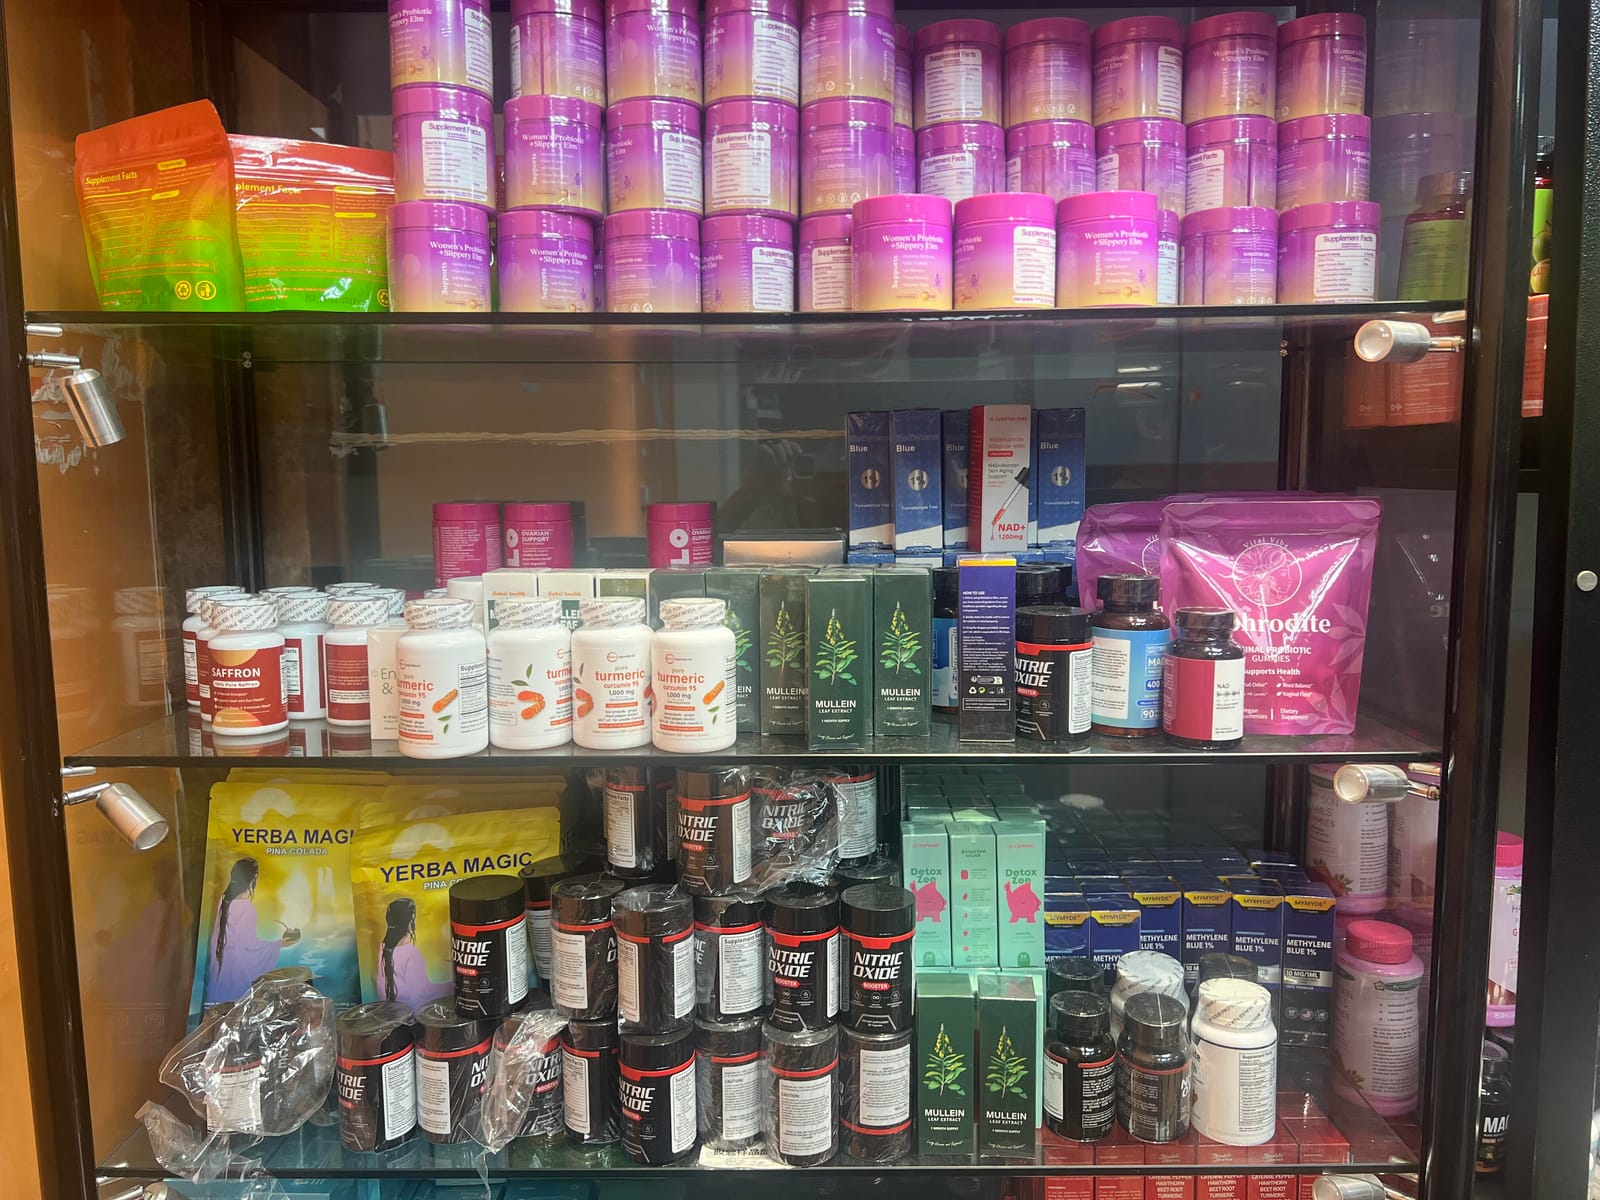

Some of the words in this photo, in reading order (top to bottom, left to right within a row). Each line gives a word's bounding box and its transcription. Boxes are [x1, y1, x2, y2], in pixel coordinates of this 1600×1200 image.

[962, 50, 976, 58] Facts
[428, 122, 466, 134] Supplement
[466, 125, 482, 136] Facts
[716, 135, 747, 144] Supplement
[562, 141, 578, 150] Elm
[85, 172, 122, 186] Supplement
[882, 234, 916, 242] Women's
[1084, 230, 1120, 240] Women's
[1323, 234, 1358, 244] Supplement
[1359, 234, 1373, 242] Facts
[430, 242, 464, 252] Women's
[892, 242, 924, 250] +Slippery
[1093, 238, 1128, 247] +Slippery
[1128, 238, 1143, 246] Elm
[439, 250, 472, 260] +Slippery
[530, 248, 563, 257] Women's
[539, 256, 571, 266] +Slippery
[572, 258, 584, 266] Elm
[1094, 252, 1102, 287] Supports
[850, 444, 868, 452] Blue
[896, 444, 916, 452] Blue
[946, 444, 965, 452] Blue
[1040, 442, 1059, 450] Blue
[910, 476, 926, 486] 1%
[1054, 472, 1069, 482] 1%
[998, 523, 1026, 532] NAD+
[1243, 537, 1266, 549] Vital
[1270, 537, 1289, 550] Vibe
[1234, 612, 1332, 634] hrodite
[1266, 646, 1312, 654] PROBIOTIC
[1015, 660, 1054, 674] NITRIC
[212, 668, 260, 678] SAFFRON
[595, 669, 646, 681] turmeric
[658, 672, 704, 684] turmeric
[398, 680, 434, 690] rmeric
[1015, 674, 1050, 688] OXIDE
[1147, 680, 1160, 688] 400
[382, 683, 393, 695] &
[766, 688, 803, 696] MULLEIN
[881, 688, 920, 696] MULLEIN
[816, 700, 856, 708] MULLEIN
[1142, 710, 1154, 719] 90
[678, 813, 718, 829] NITRIC
[232, 828, 298, 844] YERBA
[304, 829, 354, 844] MAGI
[678, 828, 714, 842] OXIDE
[380, 863, 456, 884] YERBA
[462, 852, 534, 874] MAGIC
[911, 868, 942, 876] Detox
[1006, 868, 1037, 876] Detox
[452, 937, 492, 954] NITRIC
[1141, 942, 1154, 950] LUE
[1155, 942, 1164, 950] 1%
[1235, 936, 1280, 946] METHYLENE
[1286, 940, 1332, 949] METHYLENE
[1235, 944, 1254, 952] BLUE
[1286, 947, 1305, 955] BLUE
[1306, 948, 1317, 956] 1%
[451, 952, 488, 966] OXIDE
[769, 946, 815, 965] NITRIC
[854, 952, 904, 966] NITRIC
[768, 964, 813, 978] OXIDE
[853, 965, 900, 980] OXIDE
[776, 979, 798, 987] BOOSTER
[618, 1076, 656, 1100] NITRIC
[924, 1108, 965, 1117] MULLEIN
[986, 1111, 1027, 1120] MULLEIN
